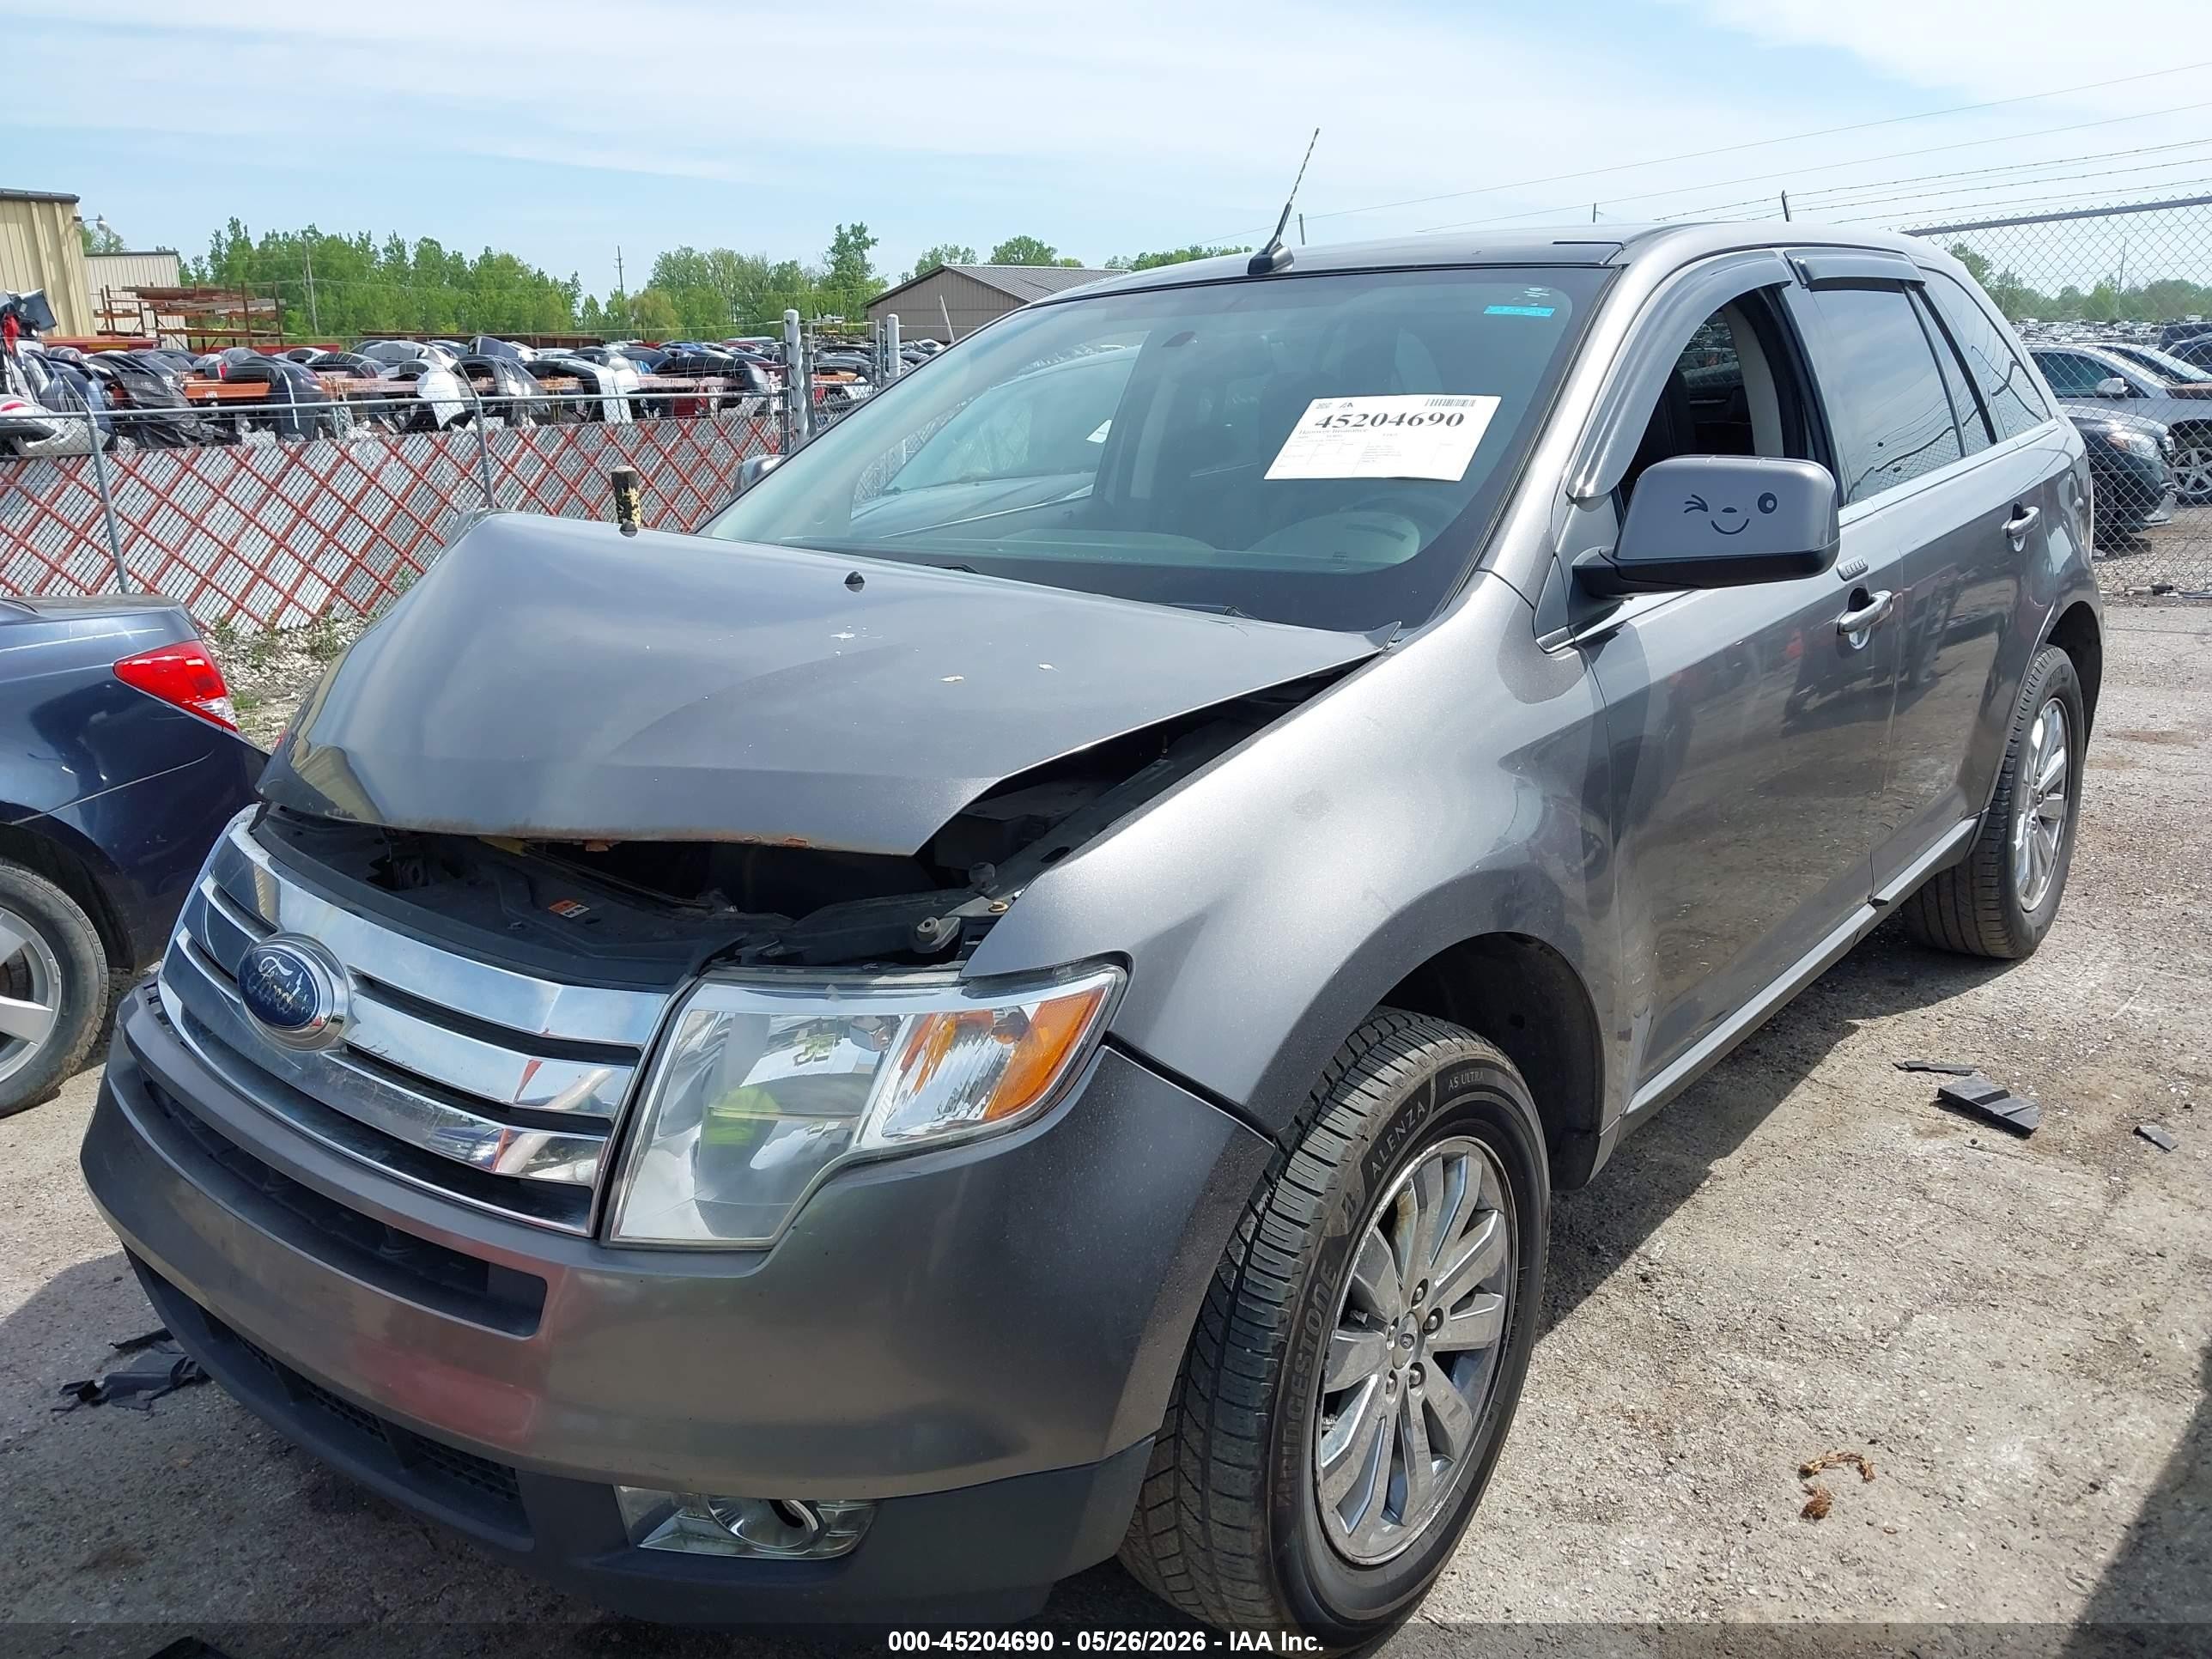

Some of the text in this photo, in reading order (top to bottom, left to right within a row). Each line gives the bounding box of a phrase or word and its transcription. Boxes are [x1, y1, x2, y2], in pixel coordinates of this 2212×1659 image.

[1314, 412, 1465, 428] 45204690
[1448, 1071, 1484, 1091] AS ULTRA
[1370, 1100, 1427, 1179] ALENZA
[1274, 1260, 1339, 1510] BRIDGESTONE
